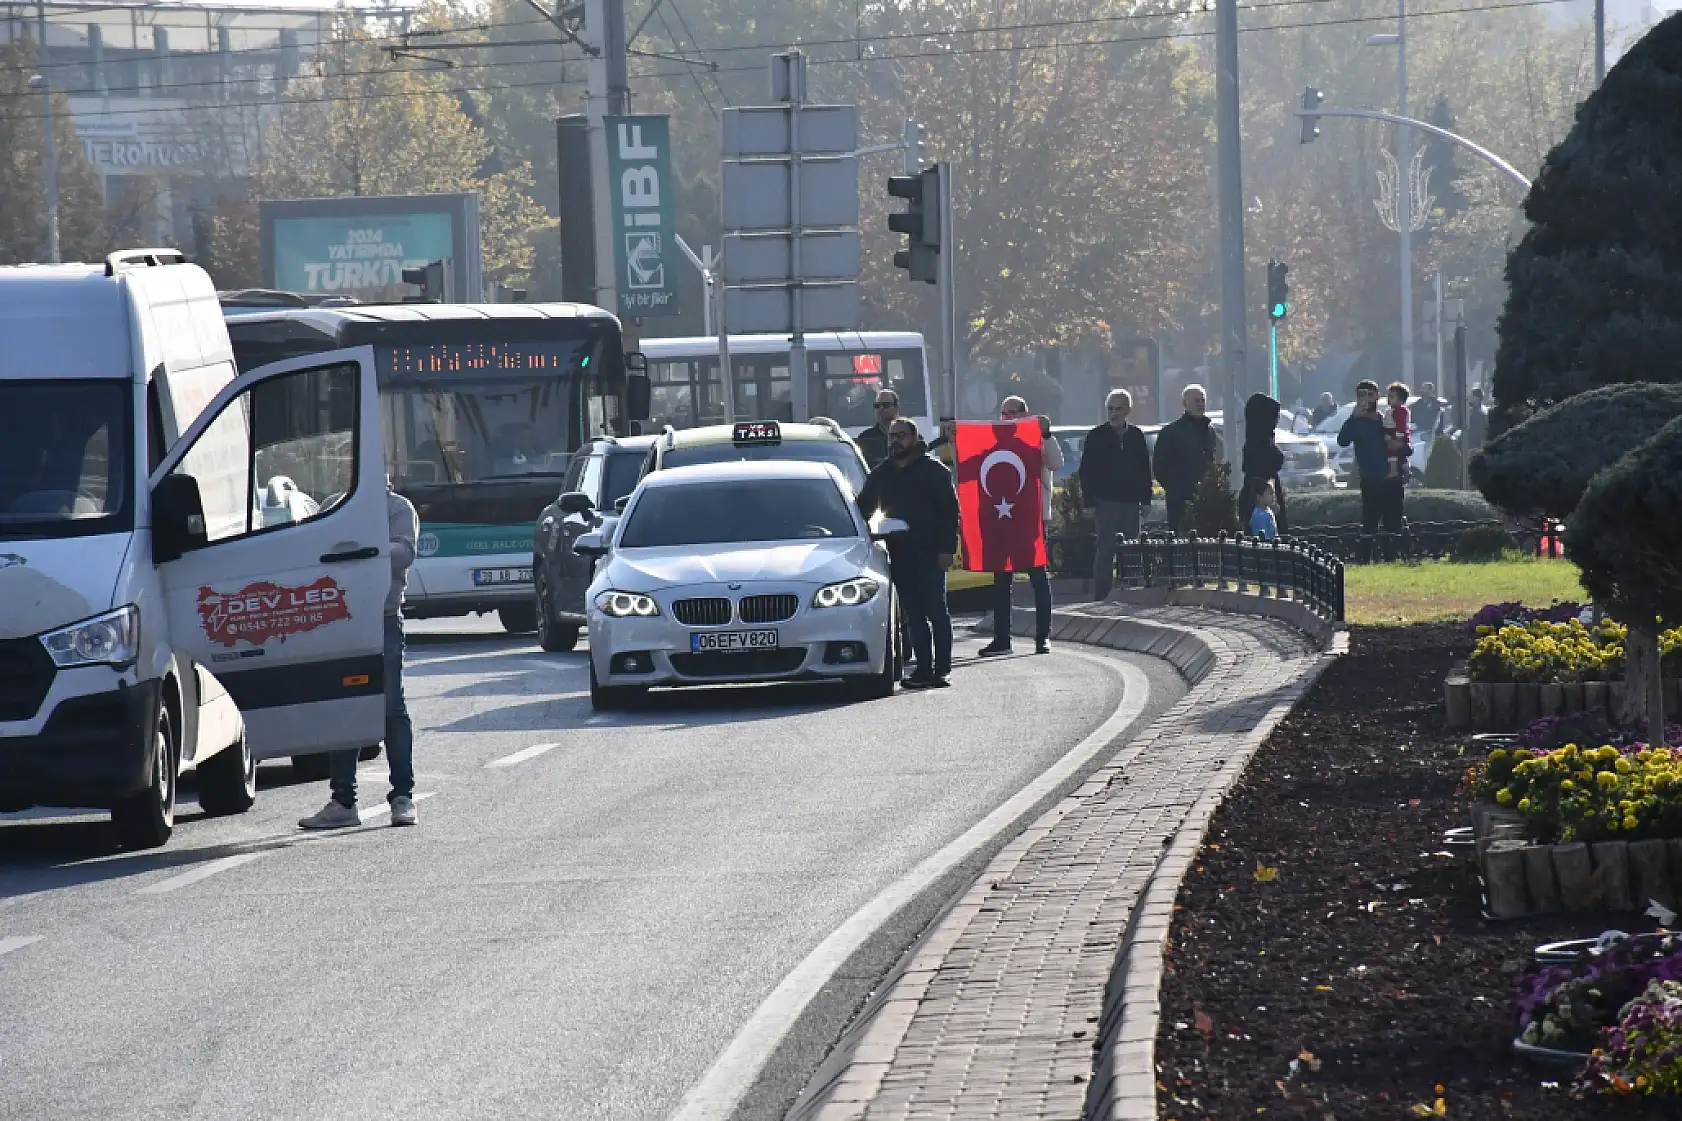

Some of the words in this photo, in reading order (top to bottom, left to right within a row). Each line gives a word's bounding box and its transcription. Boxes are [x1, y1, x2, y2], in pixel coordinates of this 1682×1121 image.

[348, 229, 382, 243] 2024
[228, 595, 282, 614] DEV
[290, 587, 339, 605] LED
